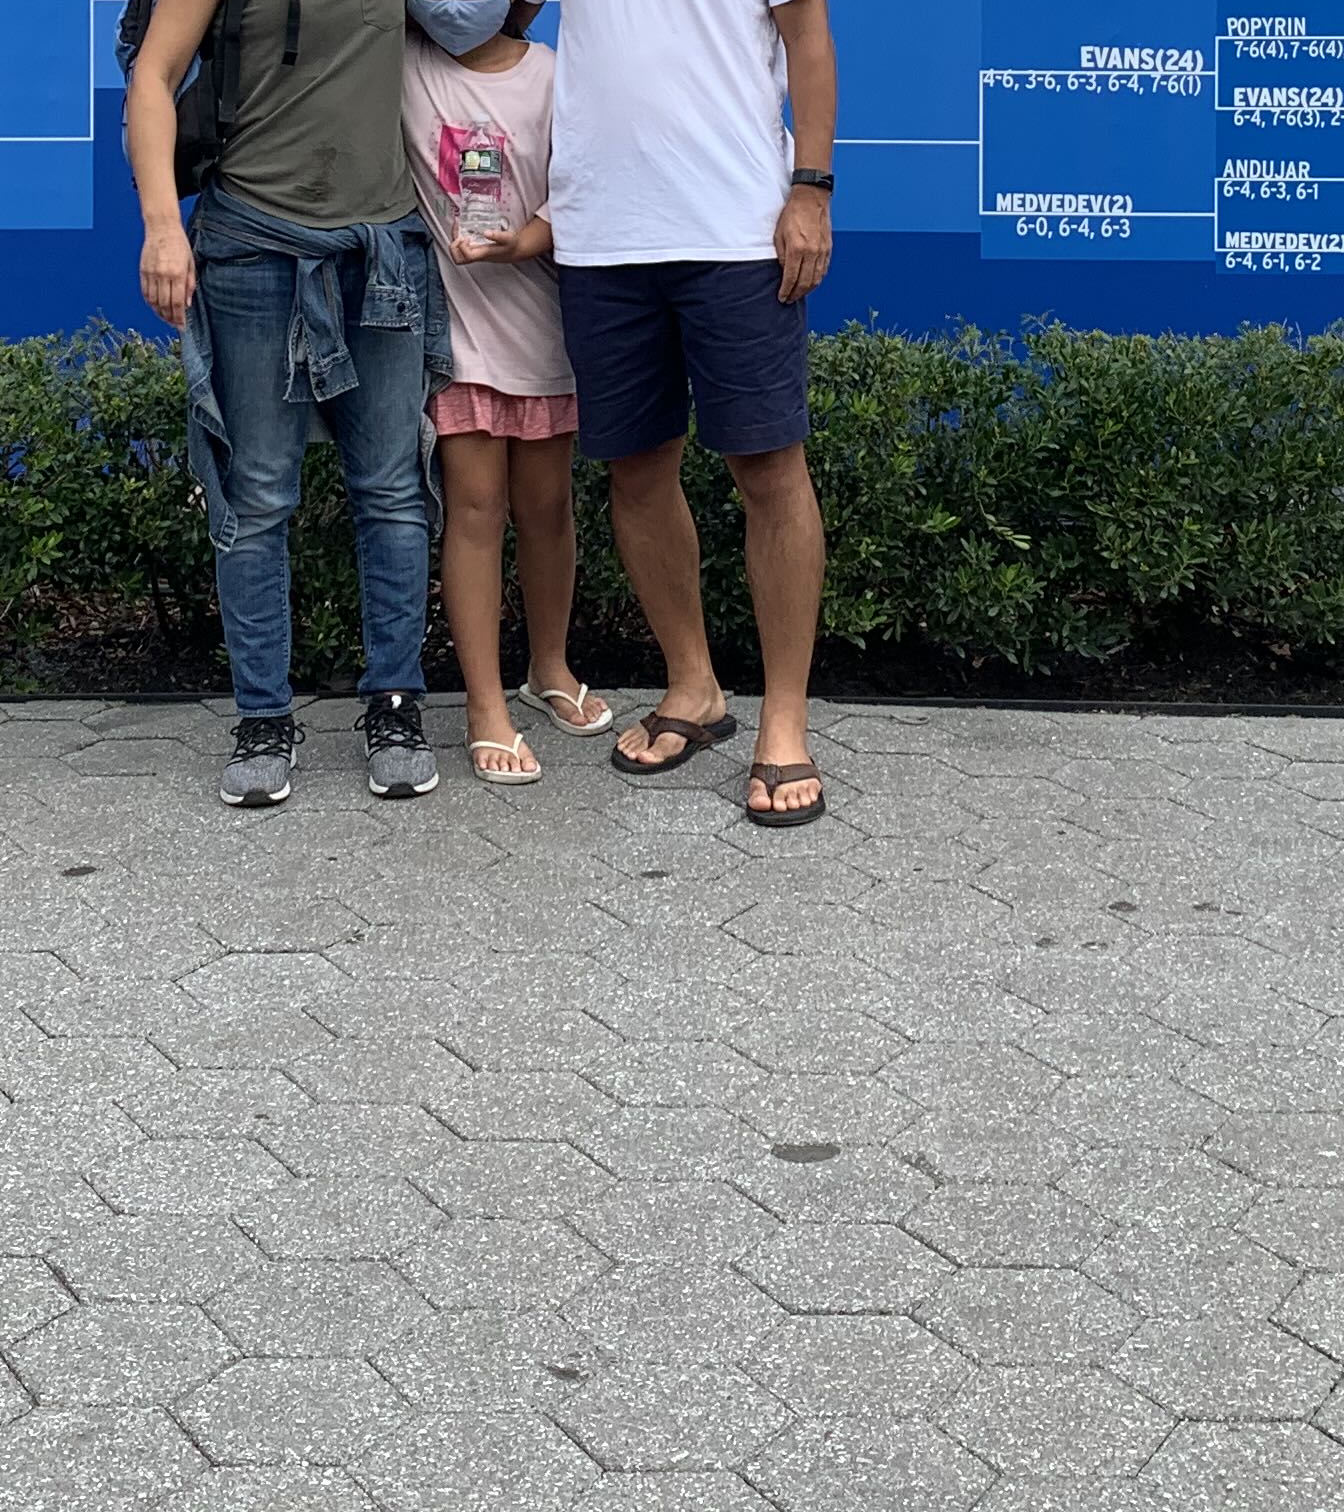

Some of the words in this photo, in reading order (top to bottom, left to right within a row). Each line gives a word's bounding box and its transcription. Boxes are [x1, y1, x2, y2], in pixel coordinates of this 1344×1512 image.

[1226, 16, 1306, 37] POPYRIN
[1080, 45, 1204, 72] EVANS(24)
[1233, 86, 1344, 108] EVANS(24)
[1222, 158, 1311, 179] ANDUJAR
[994, 192, 1133, 214] MEDVEDEV(2)
[1100, 217, 1131, 238] 6-3
[1294, 253, 1322, 271] 6-2
